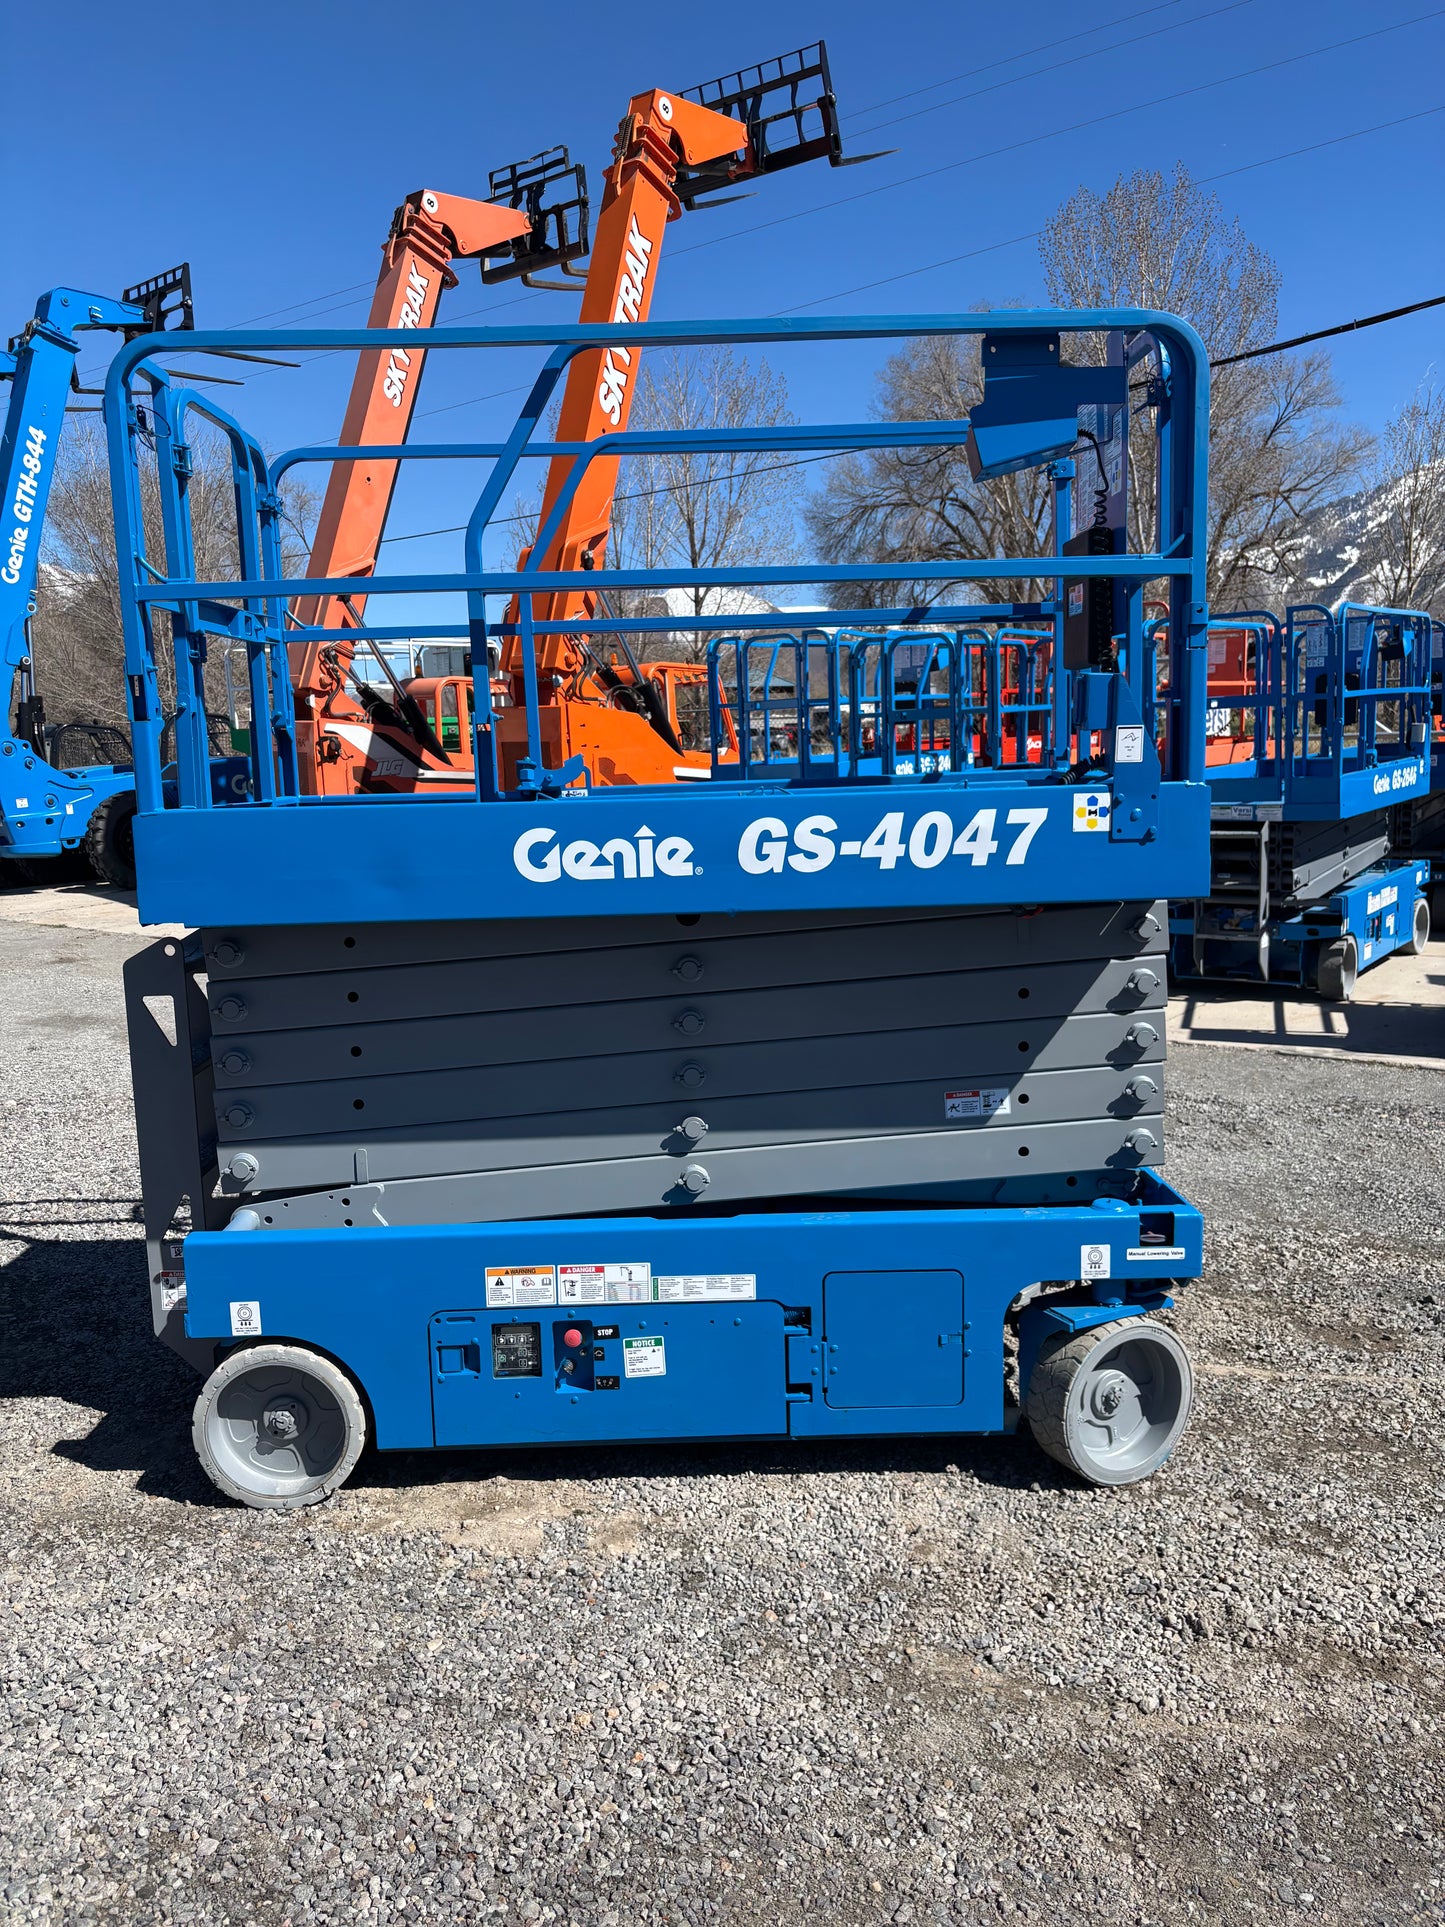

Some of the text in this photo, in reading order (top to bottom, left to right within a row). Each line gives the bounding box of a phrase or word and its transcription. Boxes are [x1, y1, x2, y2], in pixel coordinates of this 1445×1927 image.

[1, 425, 47, 584] Genie GTH-844
[371, 758, 404, 777] JLG
[896, 760, 914, 776] enie
[512, 808, 1049, 883] Genie GS-4047
[510, 1267, 537, 1275] WARNING
[572, 1266, 596, 1274] DANGER
[597, 1328, 614, 1337] STOP
[632, 1339, 656, 1348] NOTICE
